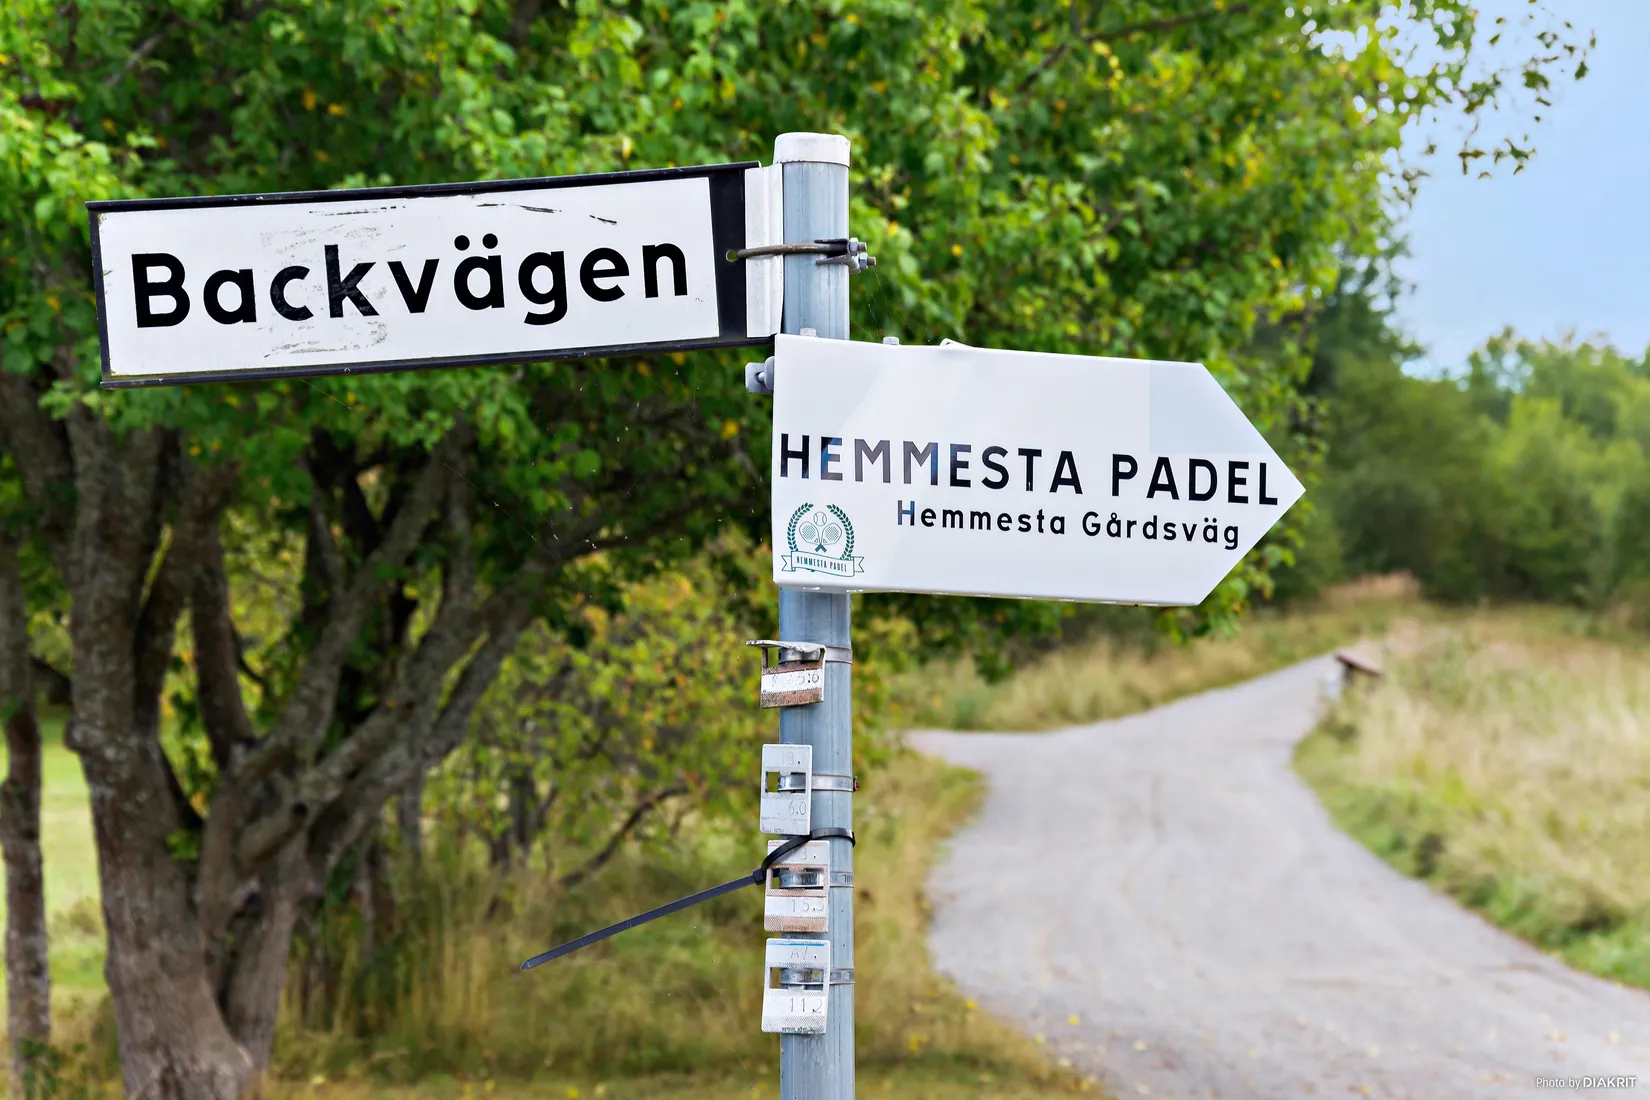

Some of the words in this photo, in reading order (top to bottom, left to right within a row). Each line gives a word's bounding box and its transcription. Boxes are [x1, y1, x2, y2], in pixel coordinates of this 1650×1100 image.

[131, 233, 688, 328] Backvägen
[780, 432, 1084, 495] HEMMESTA
[1111, 453, 1279, 506] PADEL
[897, 499, 1066, 535] Hemmesta
[1081, 508, 1239, 551] Gårdsväg
[796, 555, 828, 569] HEMMESTA
[829, 561, 848, 573] PADEL
